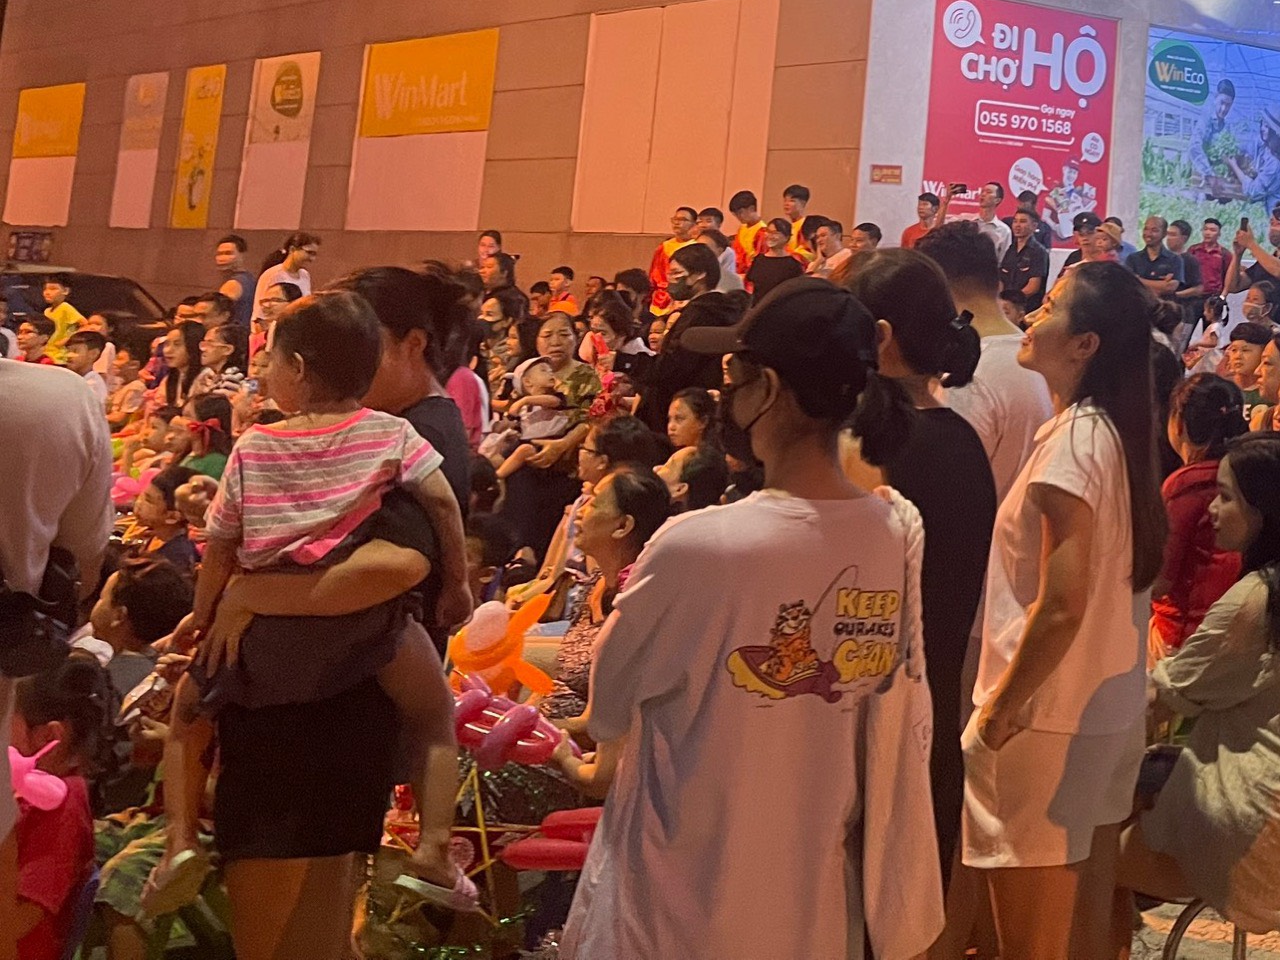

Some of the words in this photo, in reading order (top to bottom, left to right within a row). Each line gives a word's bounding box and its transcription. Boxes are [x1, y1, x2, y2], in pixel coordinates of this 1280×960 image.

[991, 22, 1019, 51] ĐI
[960, 52, 1020, 89] CHỢ
[1021, 24, 1107, 108] HỘ
[1155, 60, 1205, 85] WinEco
[374, 70, 468, 120] WinMart
[980, 111, 1008, 127] 055
[1011, 114, 1038, 131] 970
[1041, 118, 1072, 135] 1568
[1056, 109, 1075, 120] ngay
[836, 587, 900, 621] KEEP
